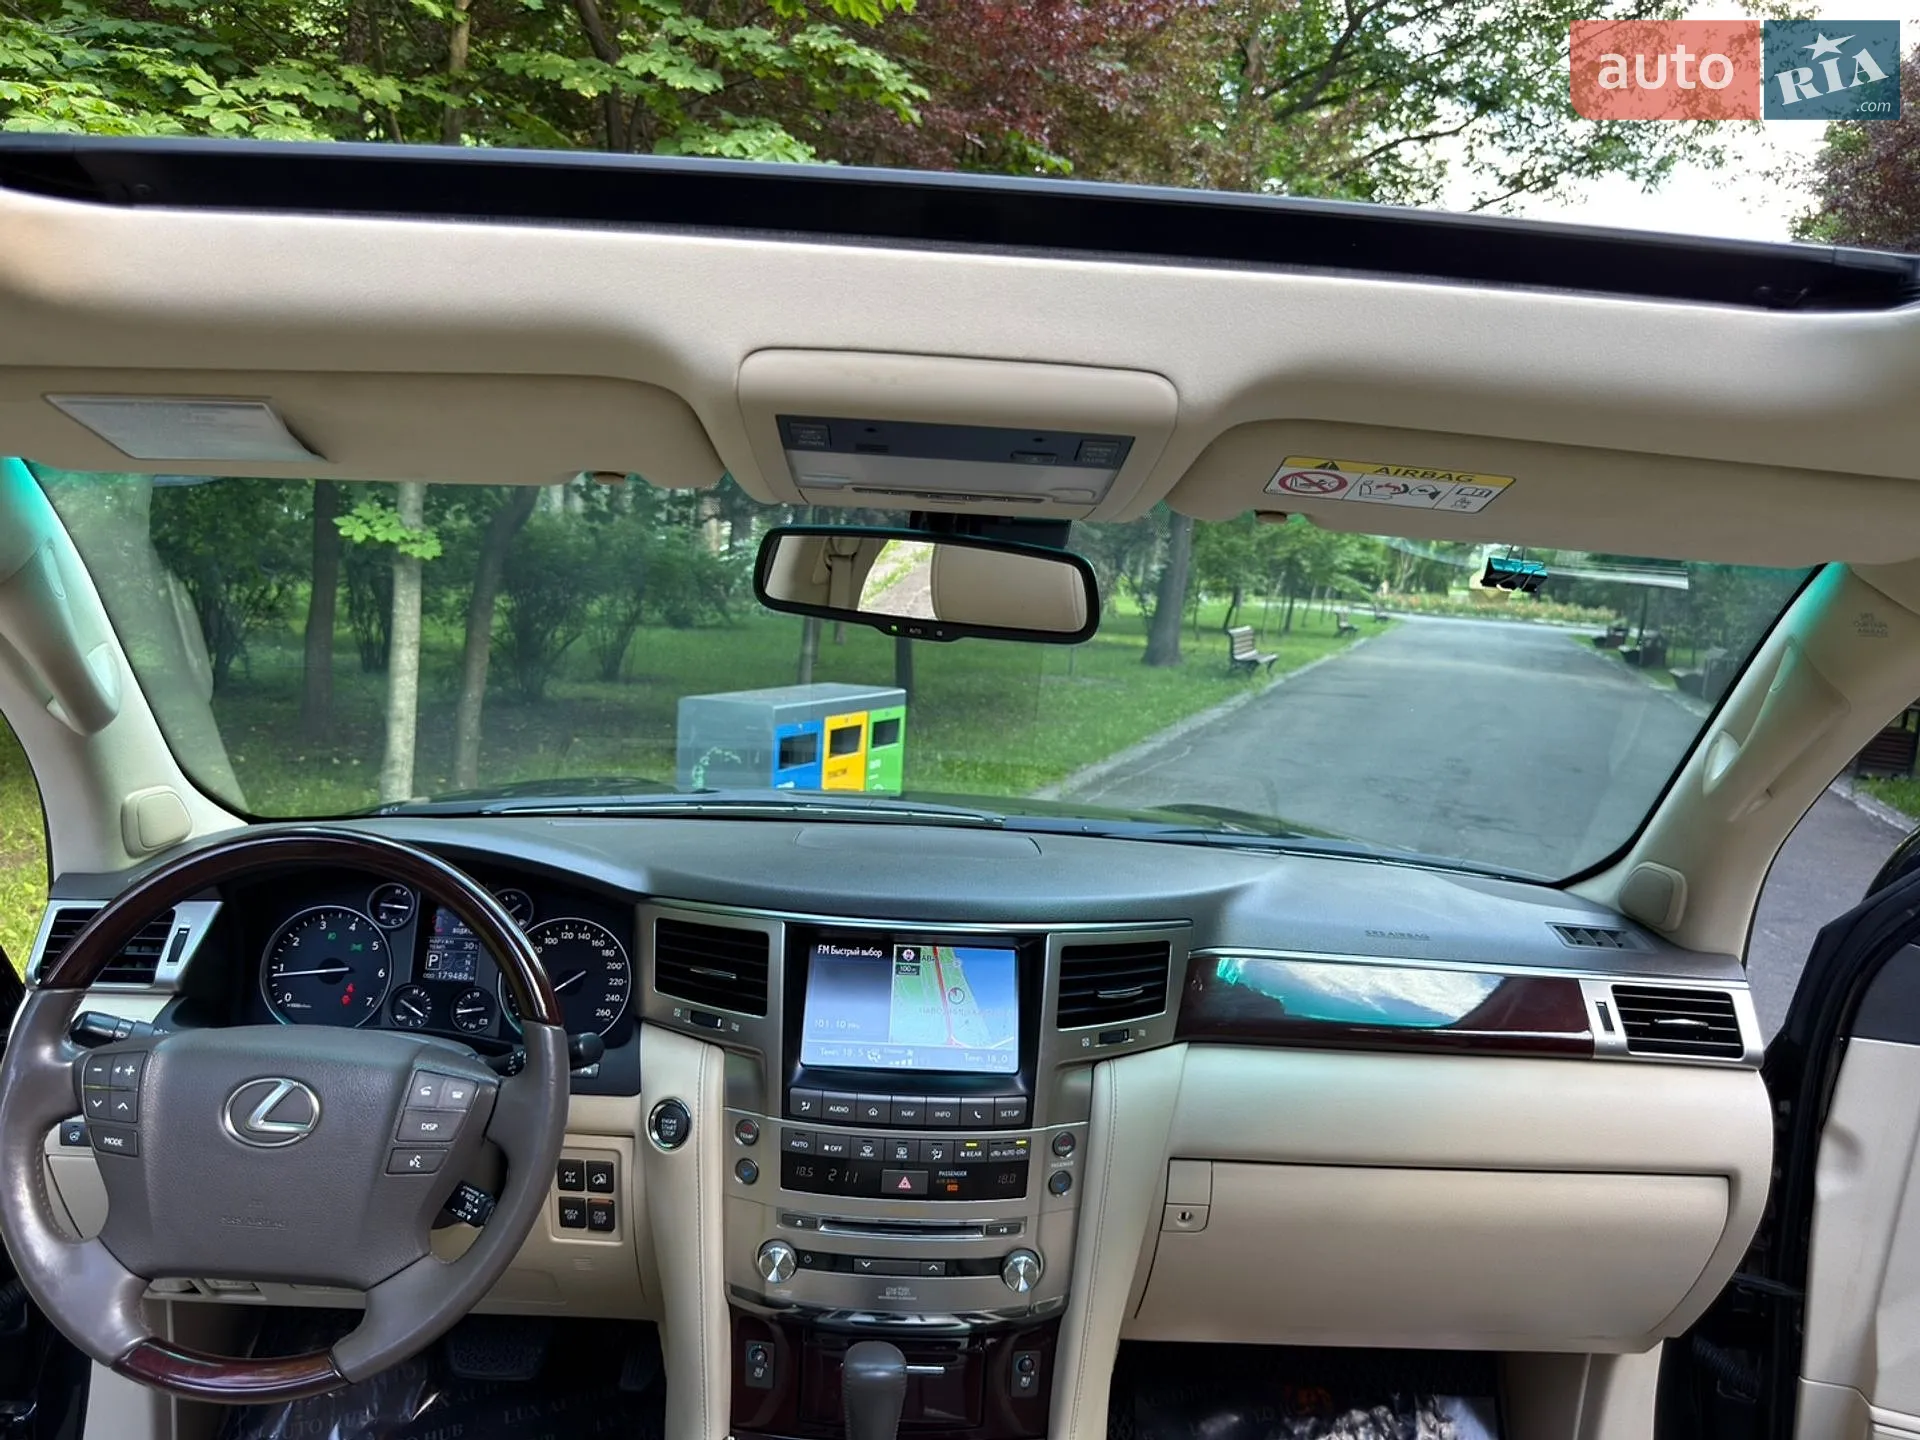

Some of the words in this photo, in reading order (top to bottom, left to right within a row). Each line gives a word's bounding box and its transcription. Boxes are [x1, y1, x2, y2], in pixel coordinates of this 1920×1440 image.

[1373, 466, 1474, 483] AIRBAG
[320, 921, 327, 930] 3
[348, 923, 356, 931] 4
[292, 938, 300, 946] 2
[371, 941, 379, 950] 5
[601, 949, 615, 957] 180
[817, 944, 830, 954] FM
[830, 945, 860, 957] Быстрый
[861, 947, 883, 958] выбор
[428, 954, 438, 967] P
[606, 962, 622, 970] 200
[378, 968, 385, 978] 6
[608, 978, 624, 986] 220
[284, 992, 292, 1002] 0
[366, 997, 373, 1006] 7
[605, 994, 620, 1002] 240
[595, 1008, 611, 1017] 260
[829, 1105, 849, 1113] AUDIO
[901, 1109, 915, 1117] NAV
[934, 1109, 951, 1118] INFO
[1000, 1109, 1020, 1118] SETUP
[421, 1122, 438, 1131] DISP
[104, 1136, 123, 1147] MODE
[791, 1140, 808, 1149] AUTO
[830, 1144, 843, 1152] OFF
[966, 1150, 982, 1158] REAR
